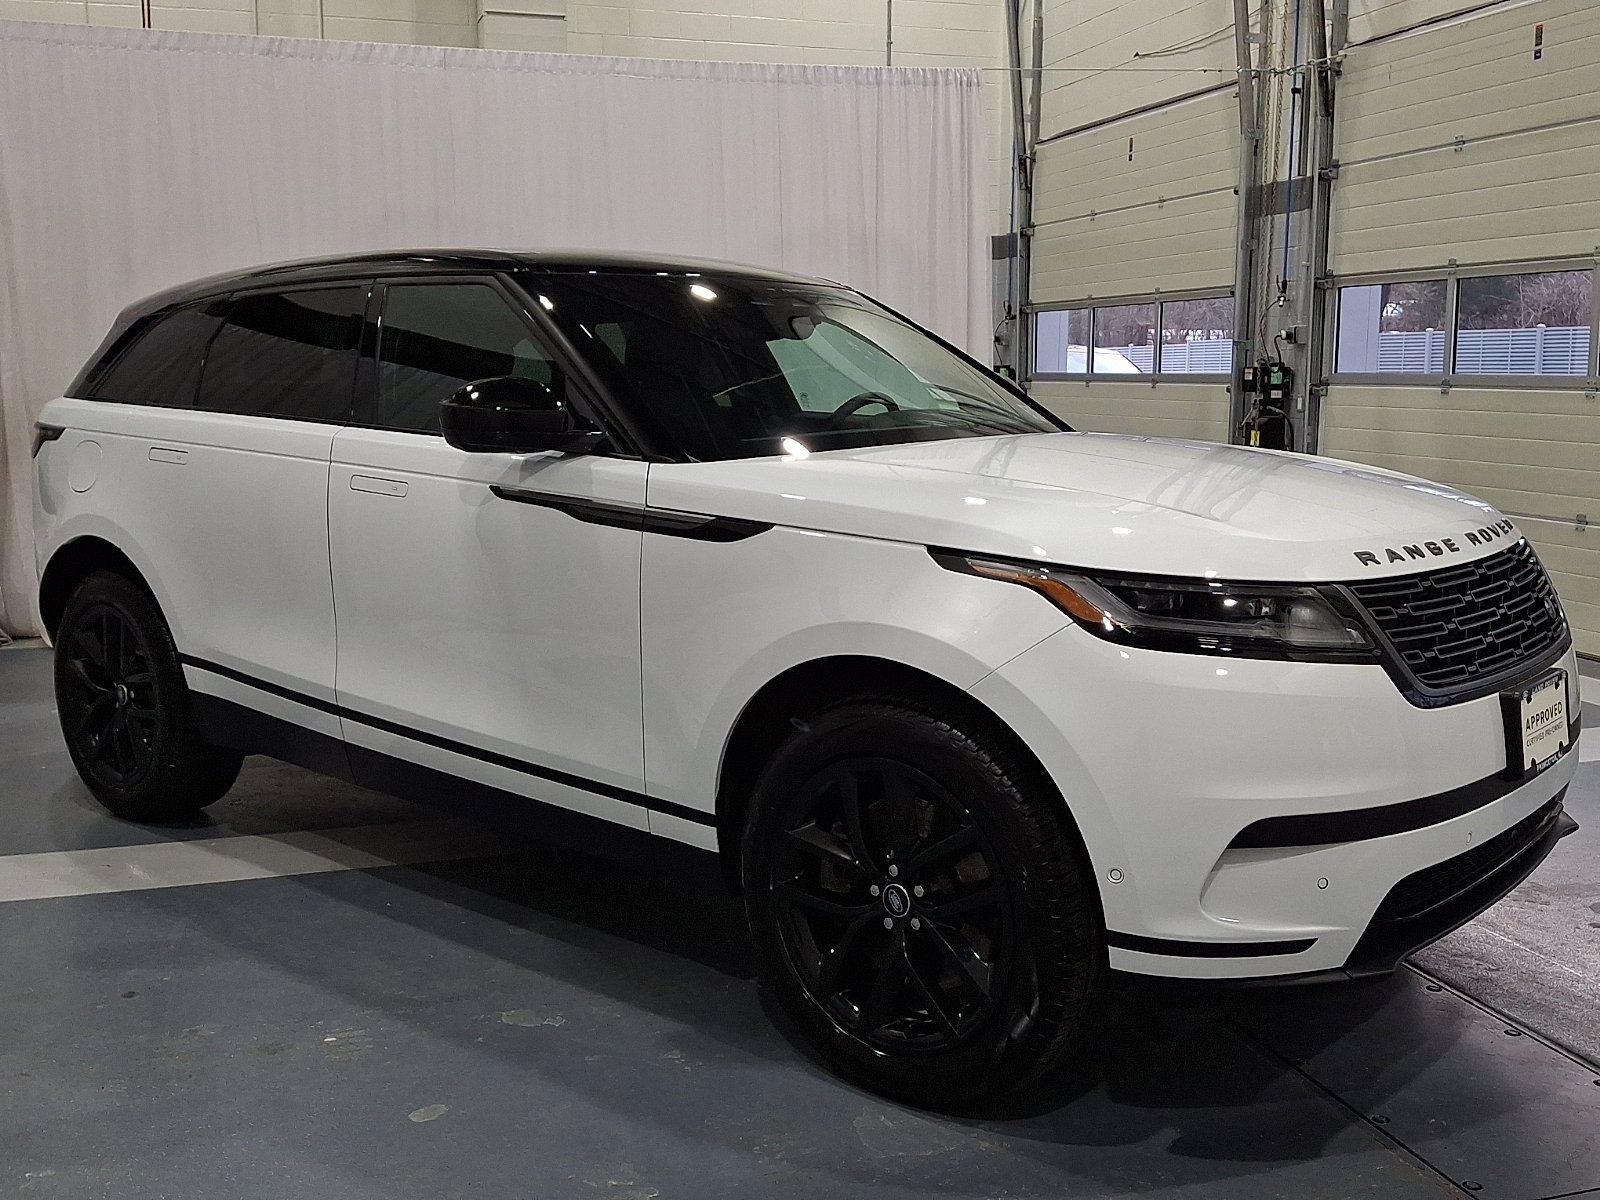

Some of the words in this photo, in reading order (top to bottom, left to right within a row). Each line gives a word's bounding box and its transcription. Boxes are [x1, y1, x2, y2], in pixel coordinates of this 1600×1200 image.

[1353, 538, 1460, 566] RANGE
[1464, 518, 1514, 546] ROVER
[1526, 701, 1563, 732] APPROVED
